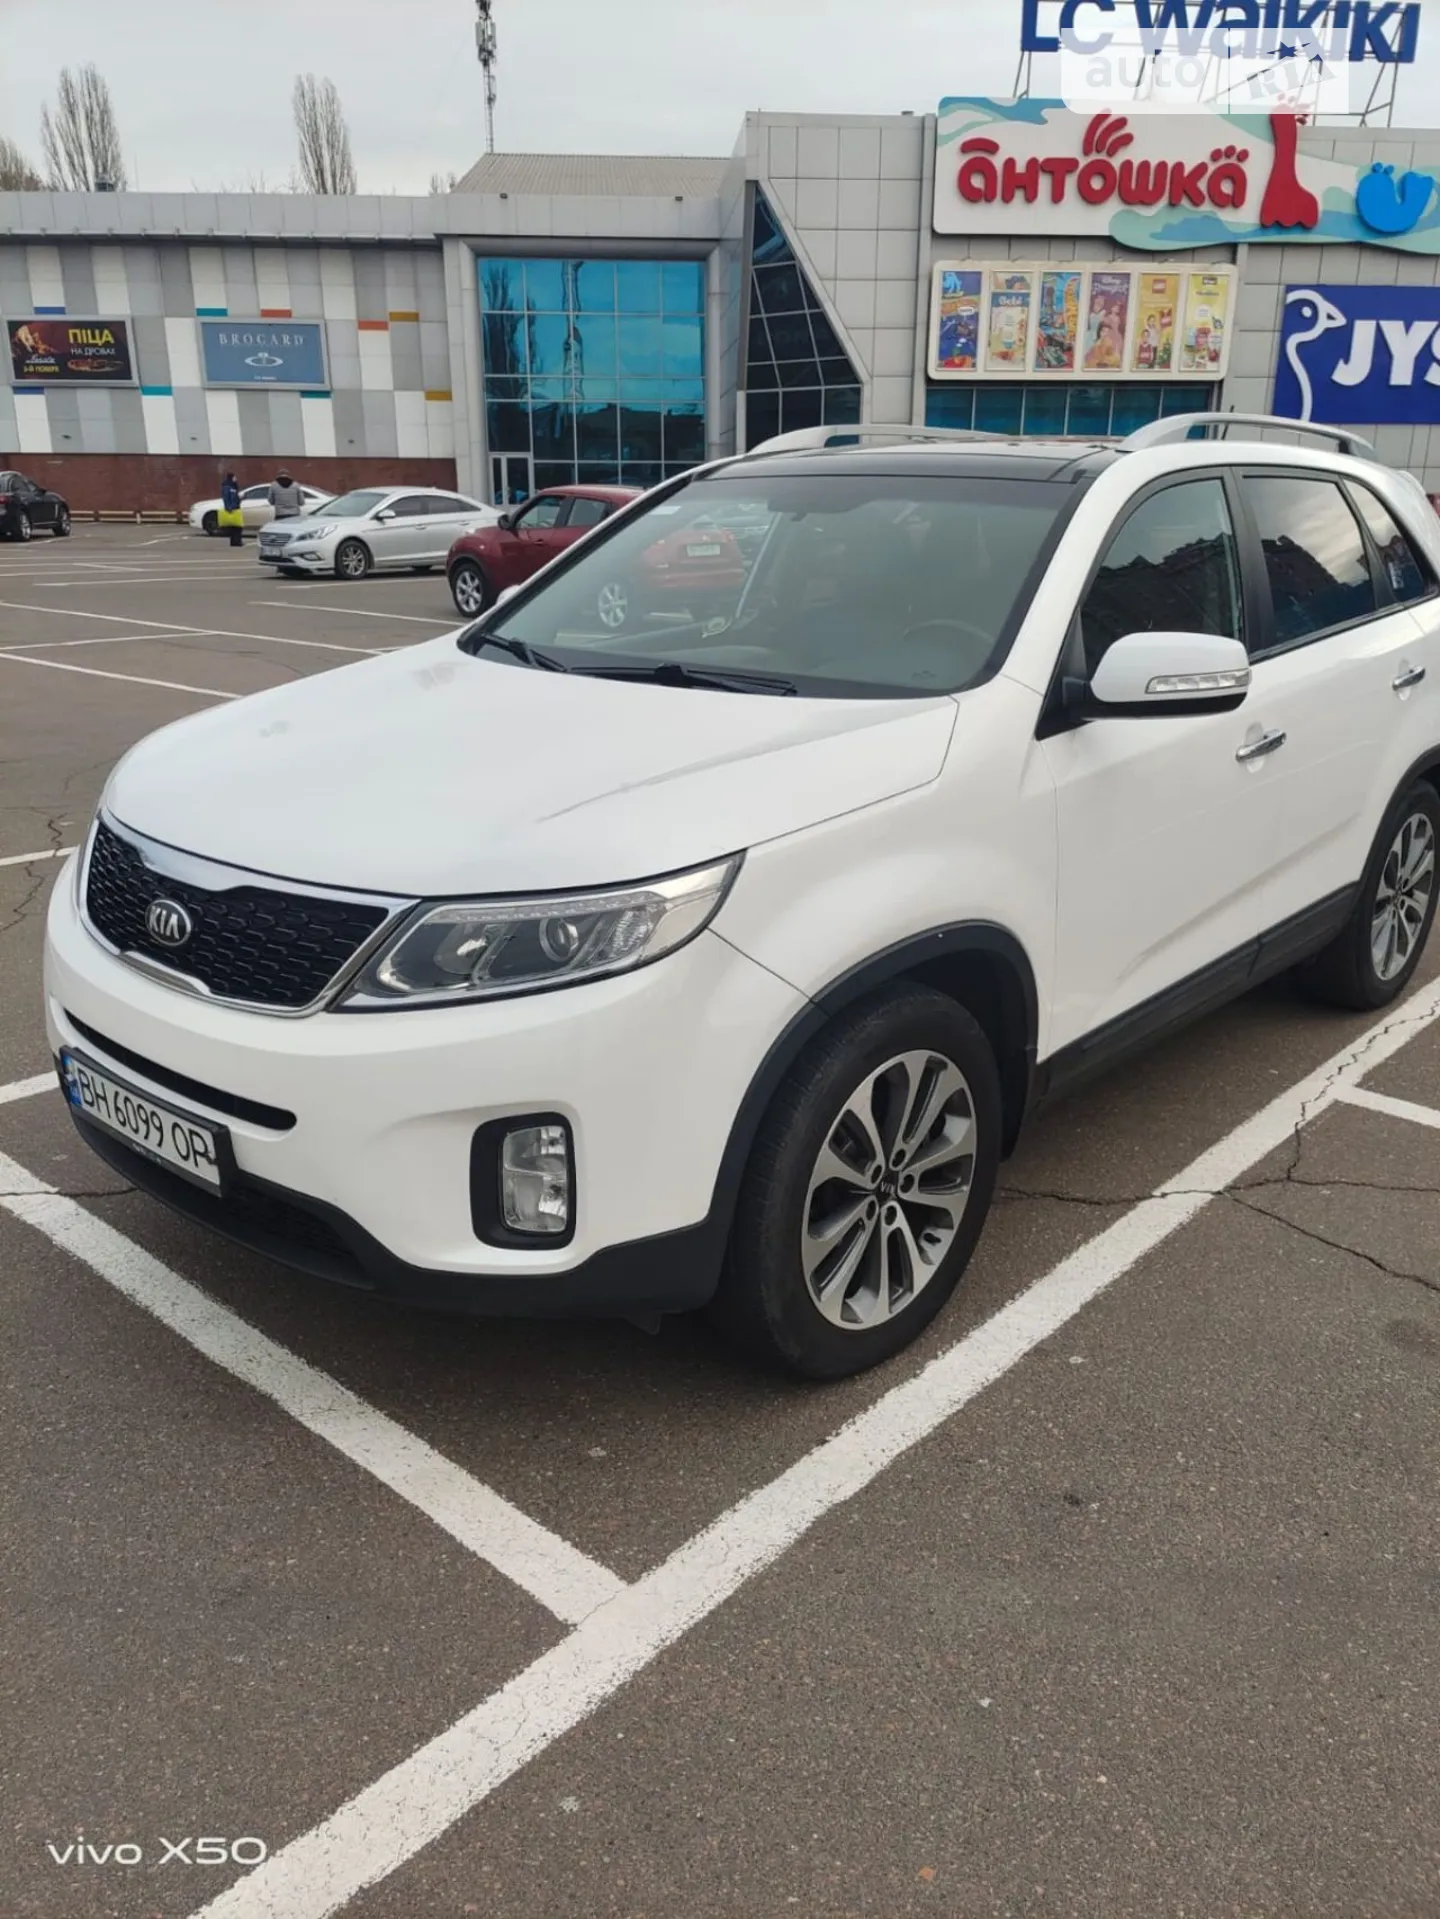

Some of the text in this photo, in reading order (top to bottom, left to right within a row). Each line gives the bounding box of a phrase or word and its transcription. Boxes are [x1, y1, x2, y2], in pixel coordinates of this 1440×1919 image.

[1021, 0, 1117, 55] LC
[68, 328, 115, 346] ПІЦА
[218, 333, 304, 346] BROCARD
[149, 905, 180, 940] KIA
[77, 1067, 111, 1119] BH
[114, 1090, 164, 1148] 6099
